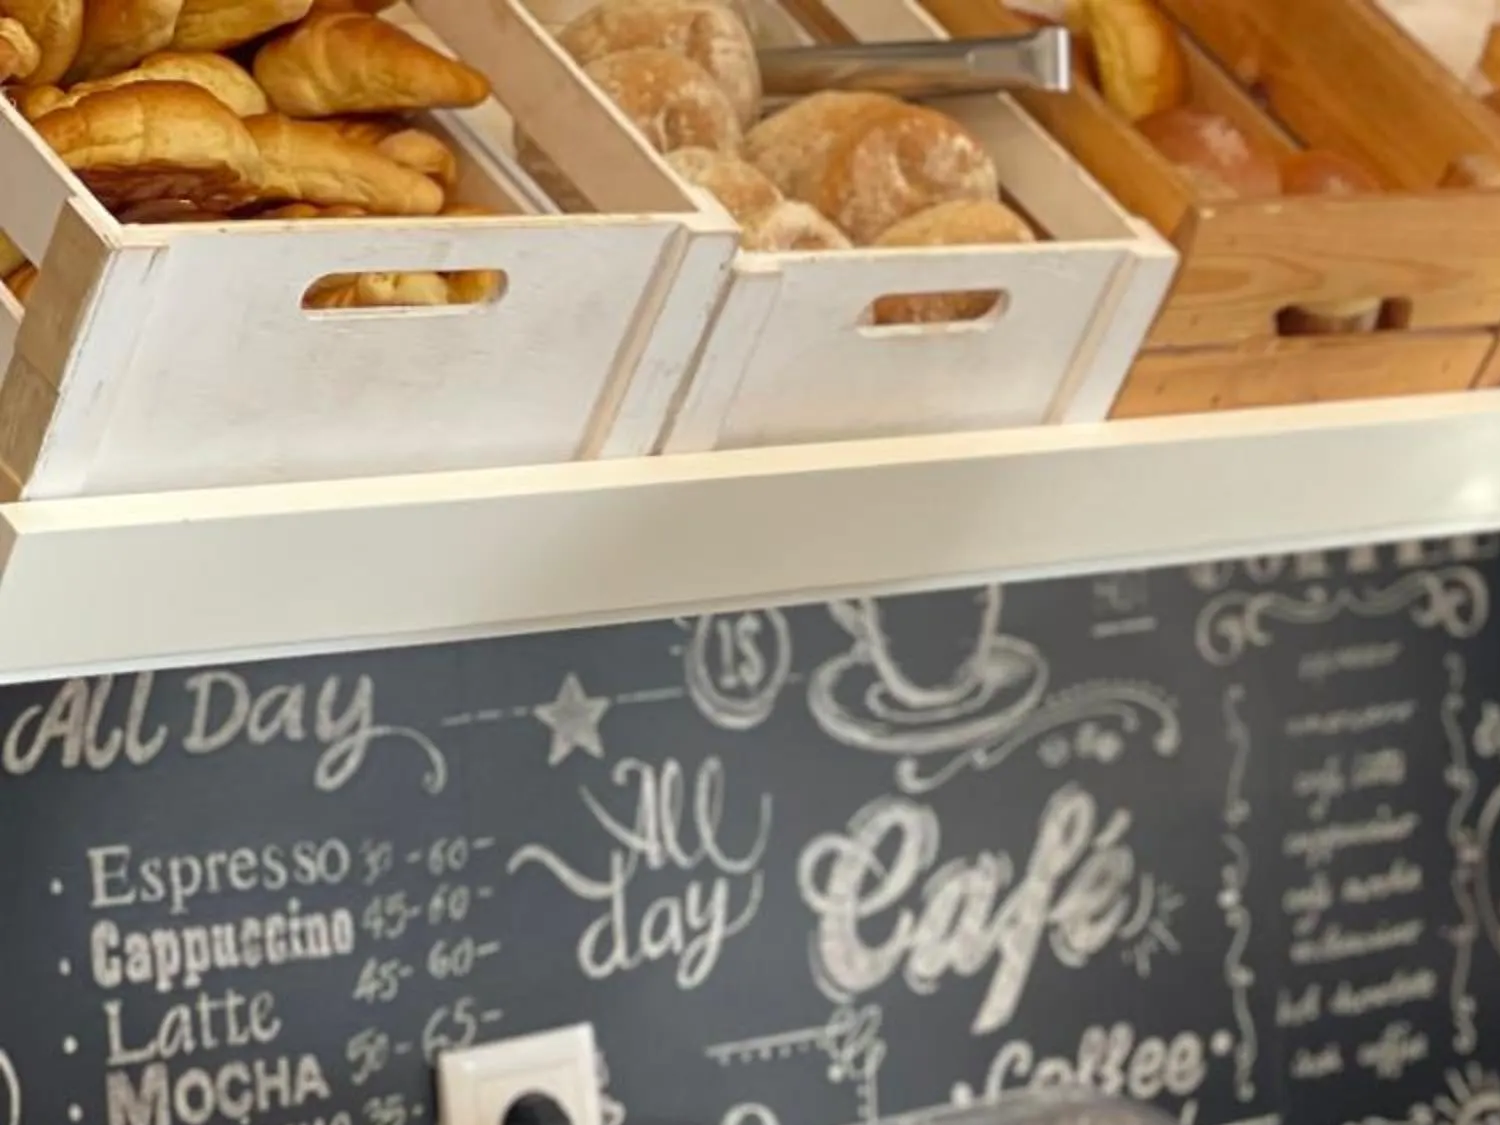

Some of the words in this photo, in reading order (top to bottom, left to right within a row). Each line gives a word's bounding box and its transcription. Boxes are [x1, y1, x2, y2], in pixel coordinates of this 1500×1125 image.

[2, 670, 168, 775] All
[183, 670, 448, 795] Day
[580, 756, 772, 874] All
[87, 836, 351, 915] Espresso
[506, 843, 764, 990] day
[797, 780, 1136, 1036] Café
[91, 898, 356, 993] Cappuccino
[103, 987, 283, 1066] Latte
[984, 1021, 1206, 1101] Coffee
